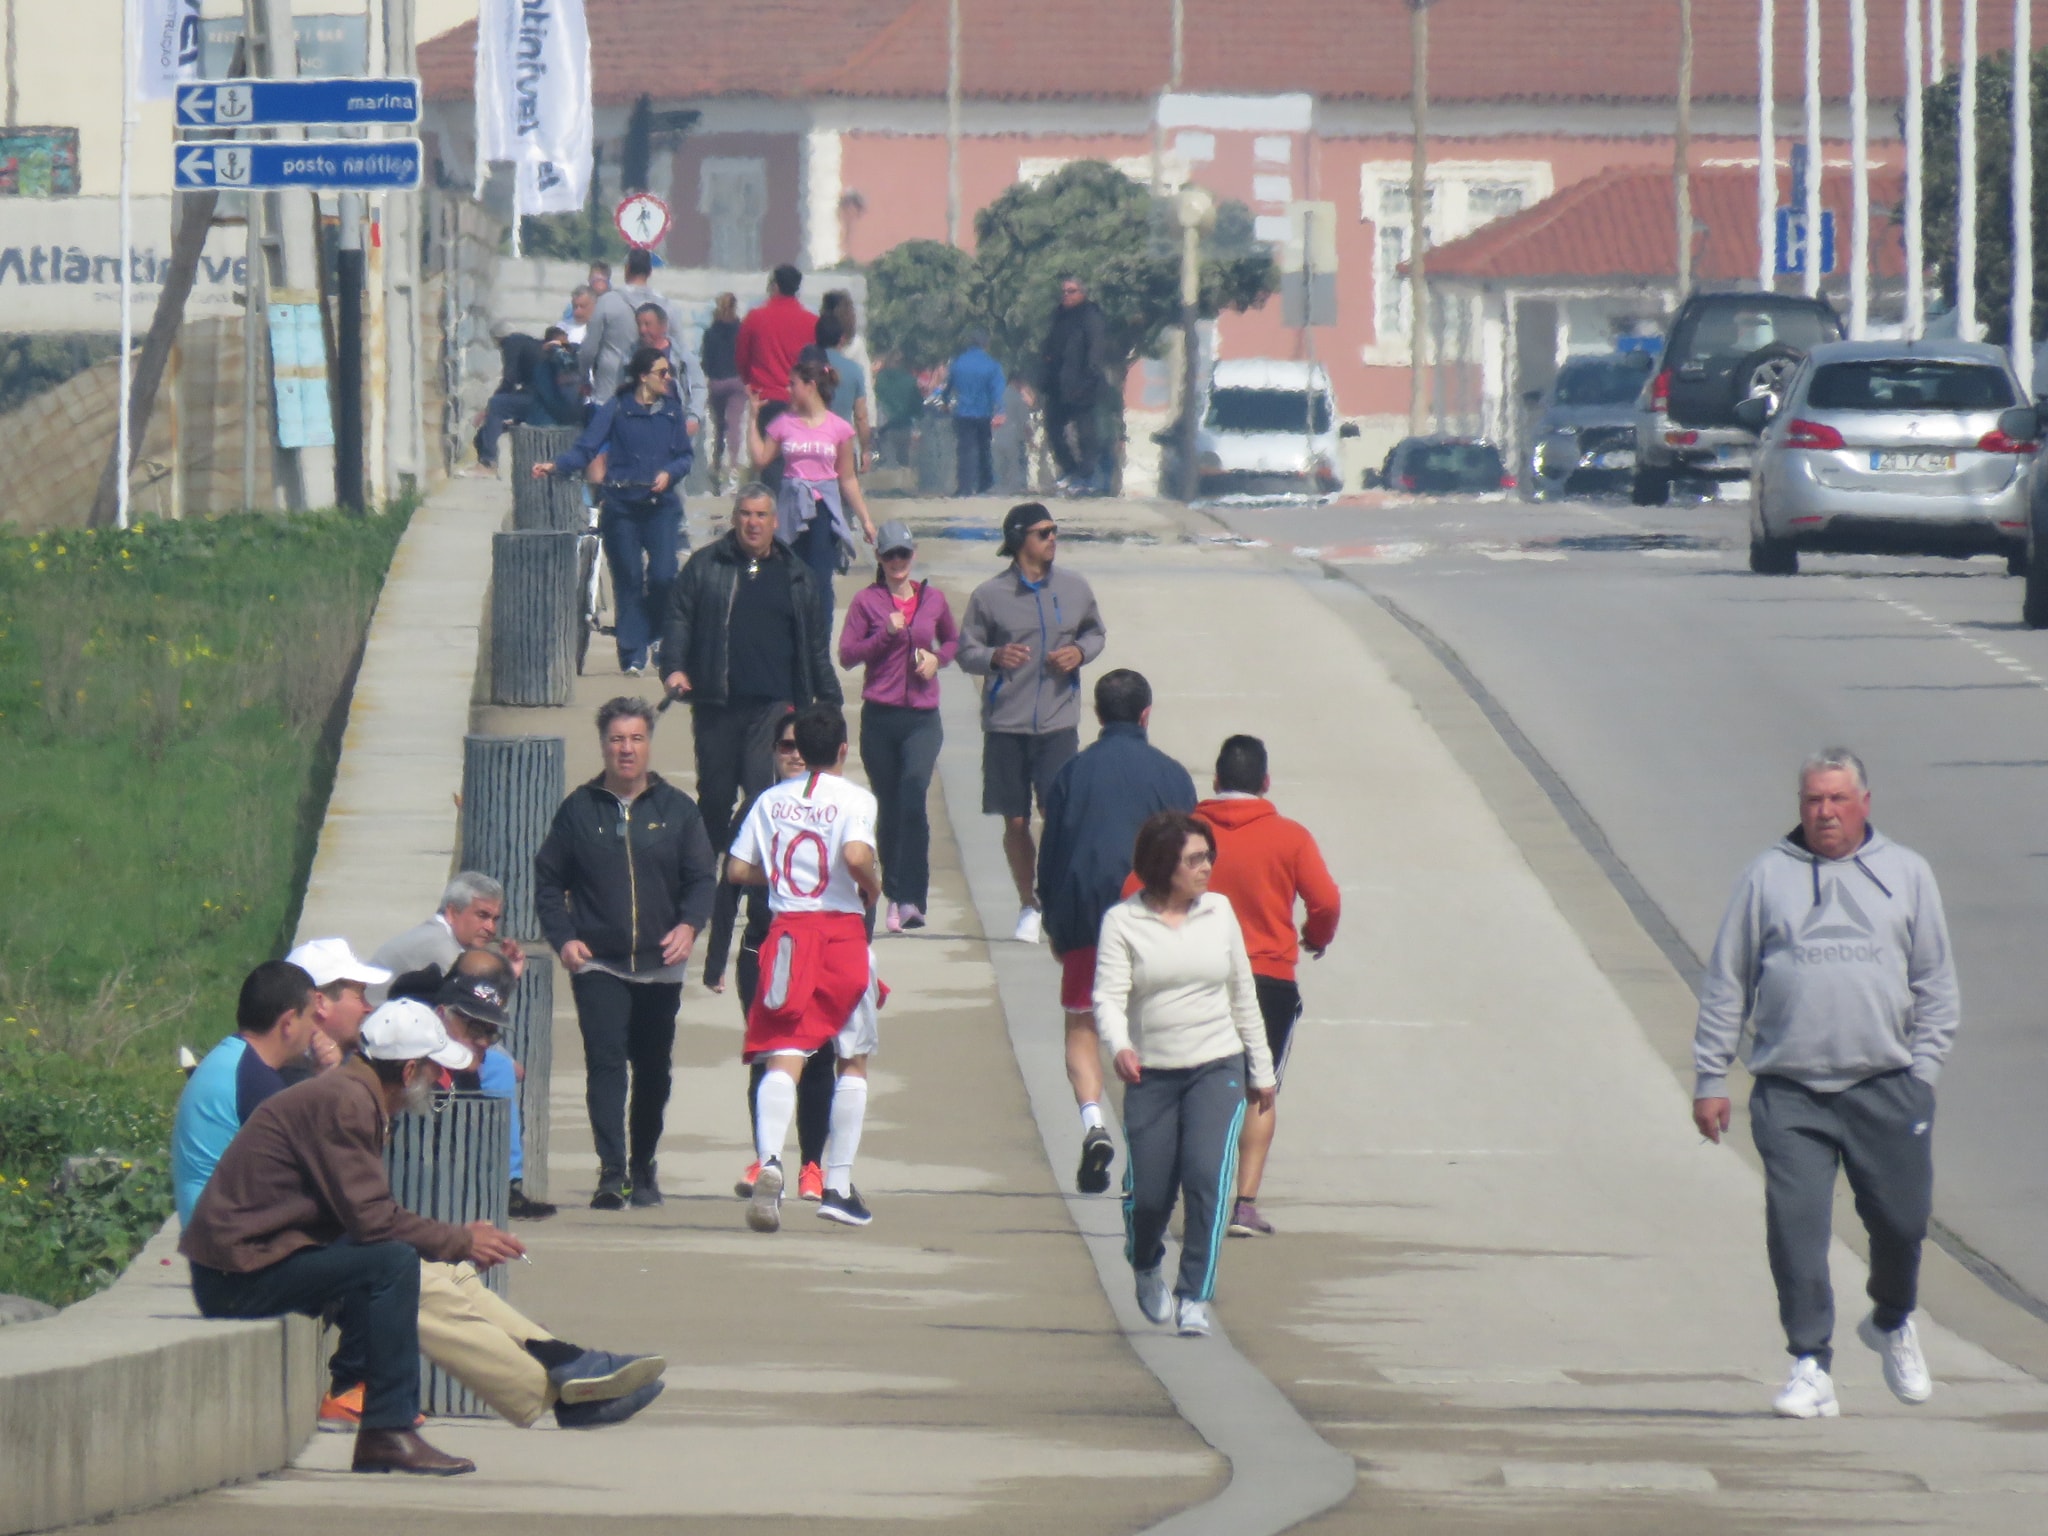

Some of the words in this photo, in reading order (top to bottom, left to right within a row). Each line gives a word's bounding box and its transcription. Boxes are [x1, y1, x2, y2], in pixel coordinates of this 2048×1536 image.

[347, 93, 413, 110] marina
[282, 156, 336, 176] posto
[783, 441, 838, 457] SMITH
[770, 802, 838, 824] GUSTAVO
[770, 829, 829, 899] 10
[1792, 942, 1882, 966] Reebok
